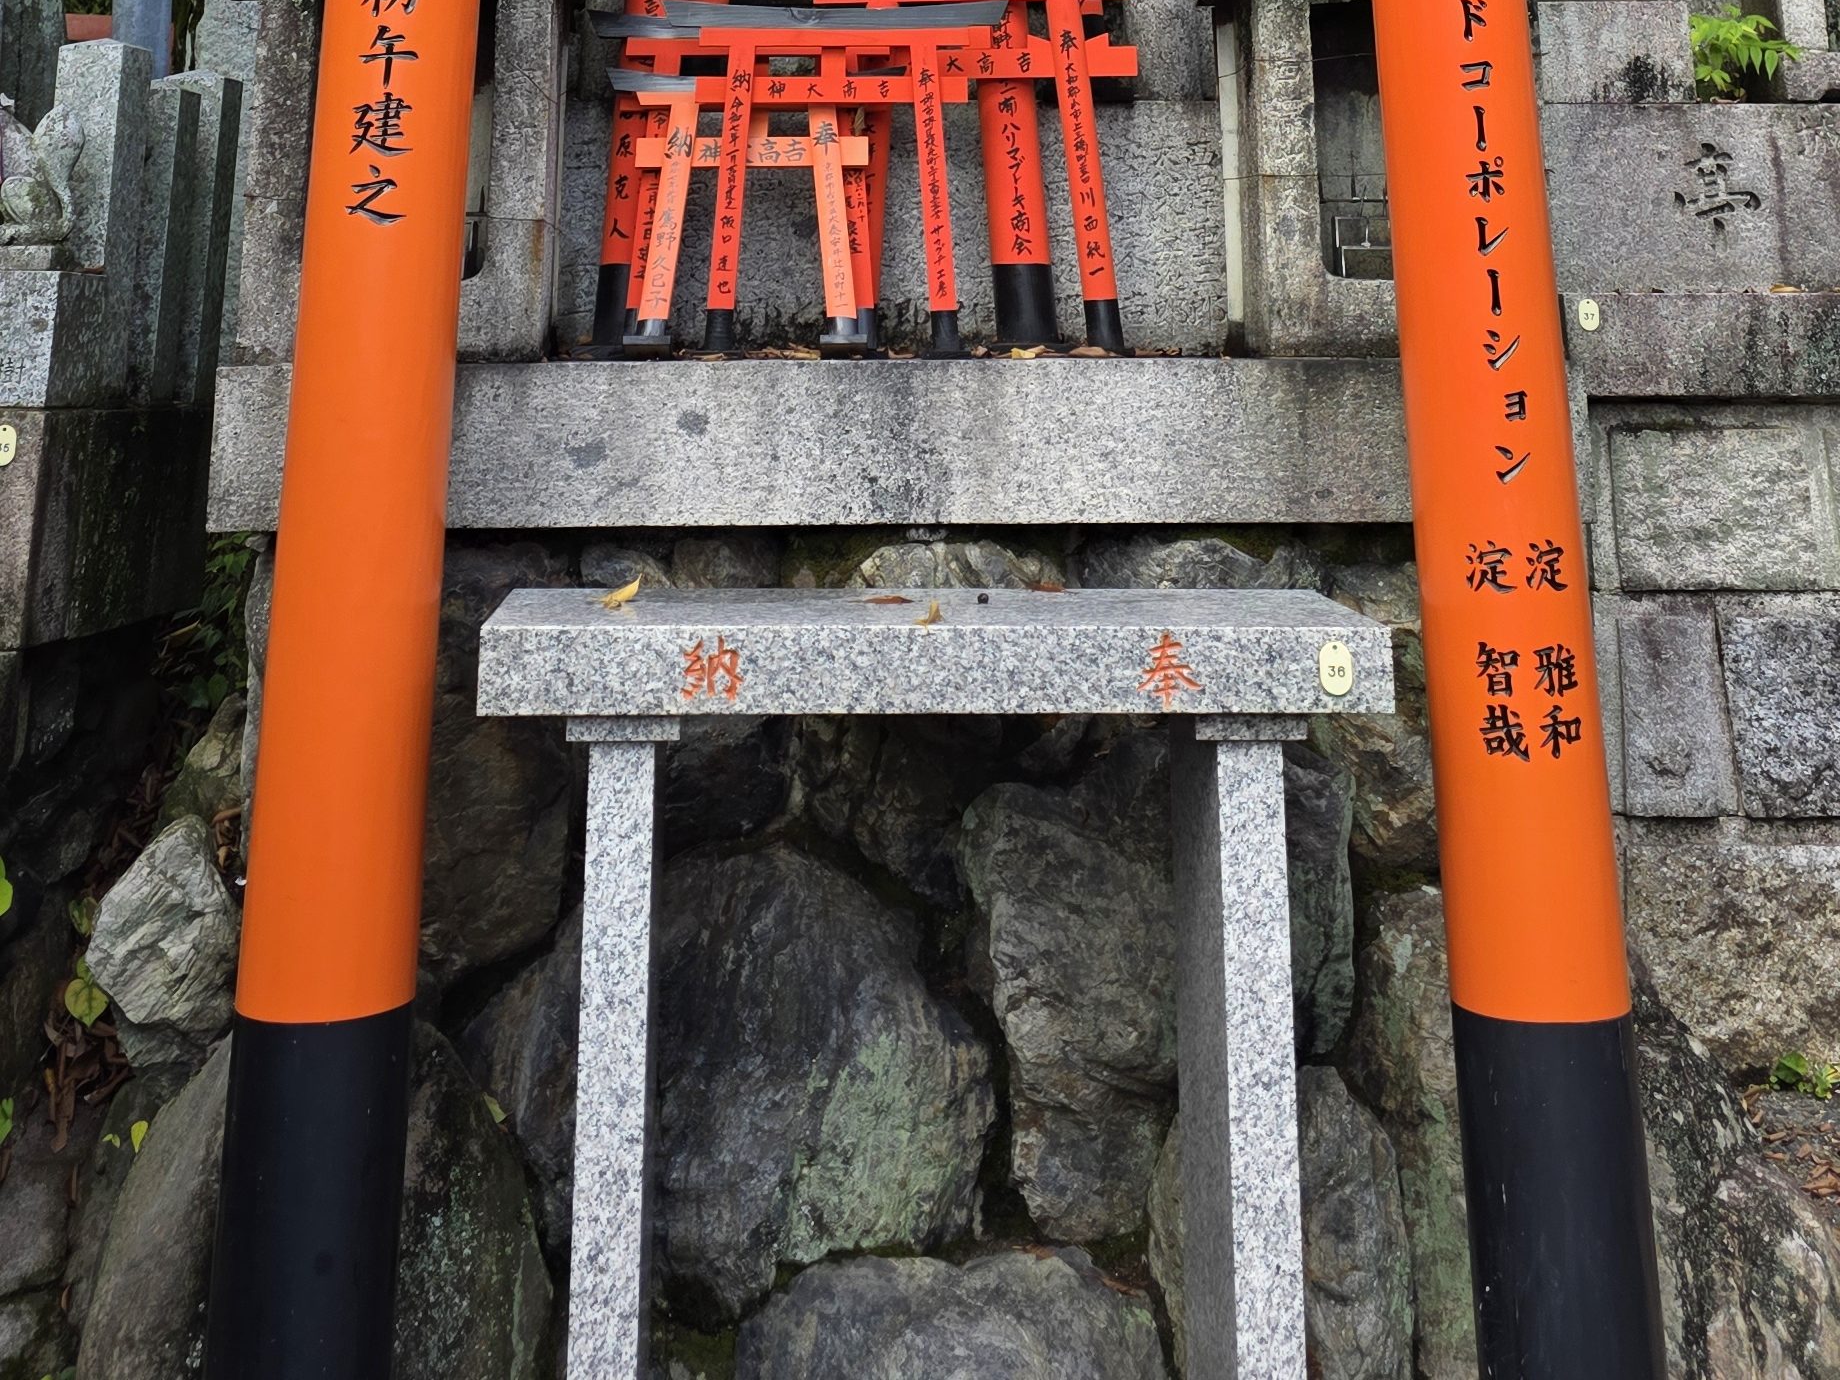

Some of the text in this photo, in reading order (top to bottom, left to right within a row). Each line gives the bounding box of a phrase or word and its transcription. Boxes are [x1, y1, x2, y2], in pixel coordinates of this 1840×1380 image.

[1060, 29, 1079, 61] 奉
[730, 69, 752, 94] 納
[918, 68, 936, 93] 奉
[664, 126, 692, 160] 納
[812, 121, 840, 157] 奉
[1583, 312, 1596, 322] 37
[680, 635, 744, 702] 納
[1137, 631, 1203, 709] 奉
[1327, 665, 1345, 679] 36
